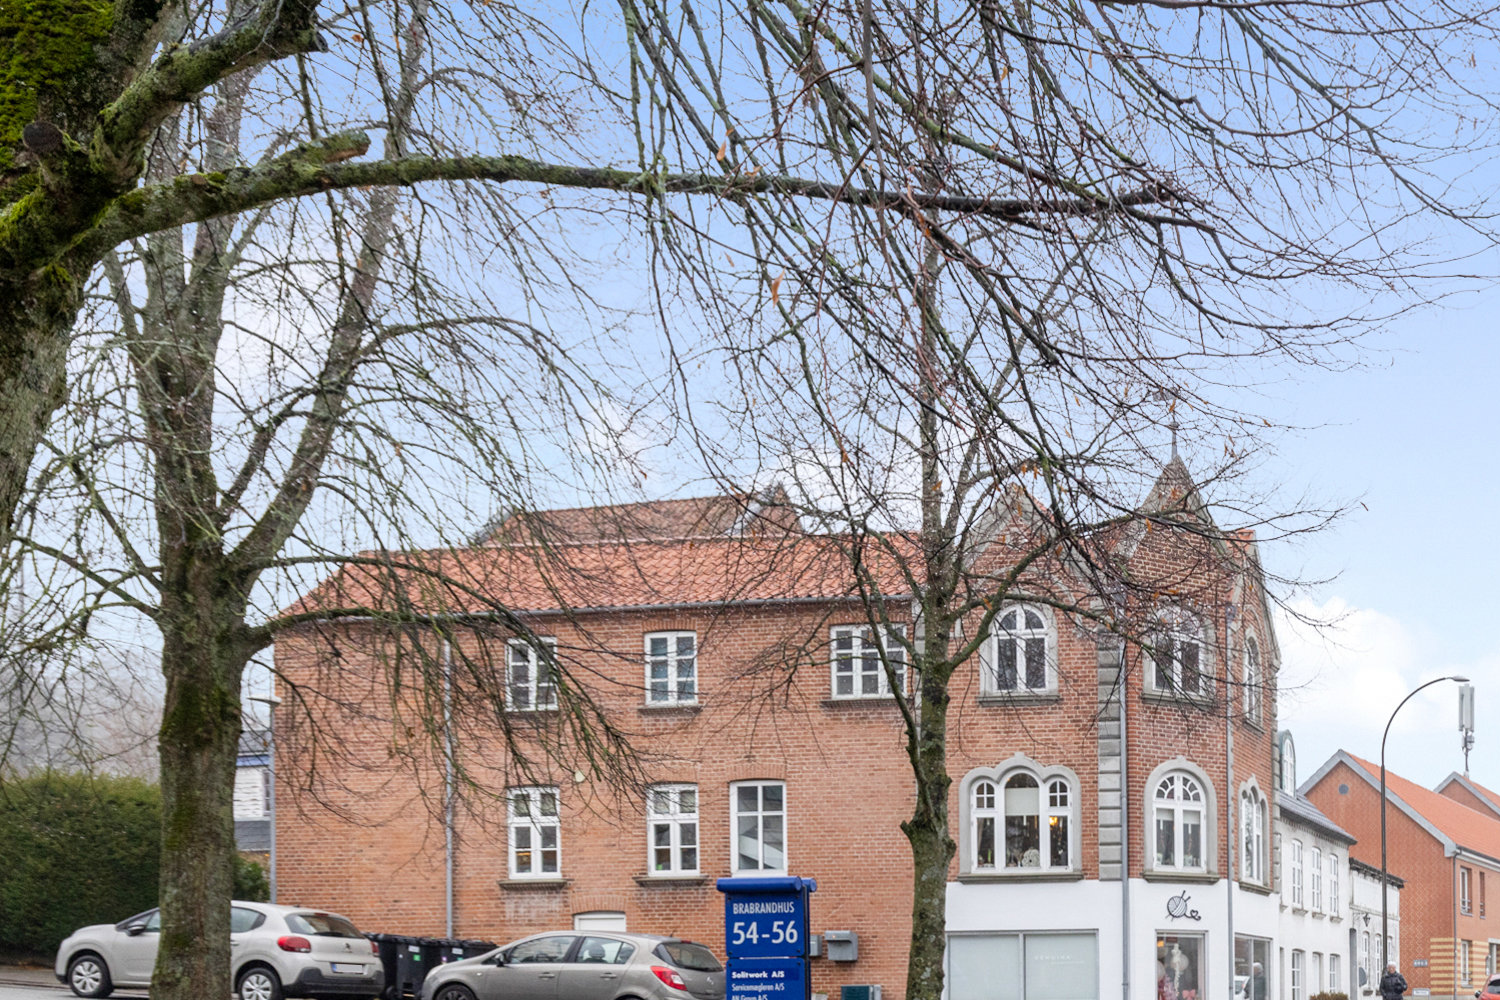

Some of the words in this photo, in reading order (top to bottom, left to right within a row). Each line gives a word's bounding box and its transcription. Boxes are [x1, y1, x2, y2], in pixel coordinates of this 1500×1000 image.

[733, 901, 795, 915] BRABRANDHUS
[732, 920, 799, 945] 54-56
[731, 971, 768, 979] Solitwork
[771, 970, 785, 978] A/S
[774, 982, 785, 991] A/S
